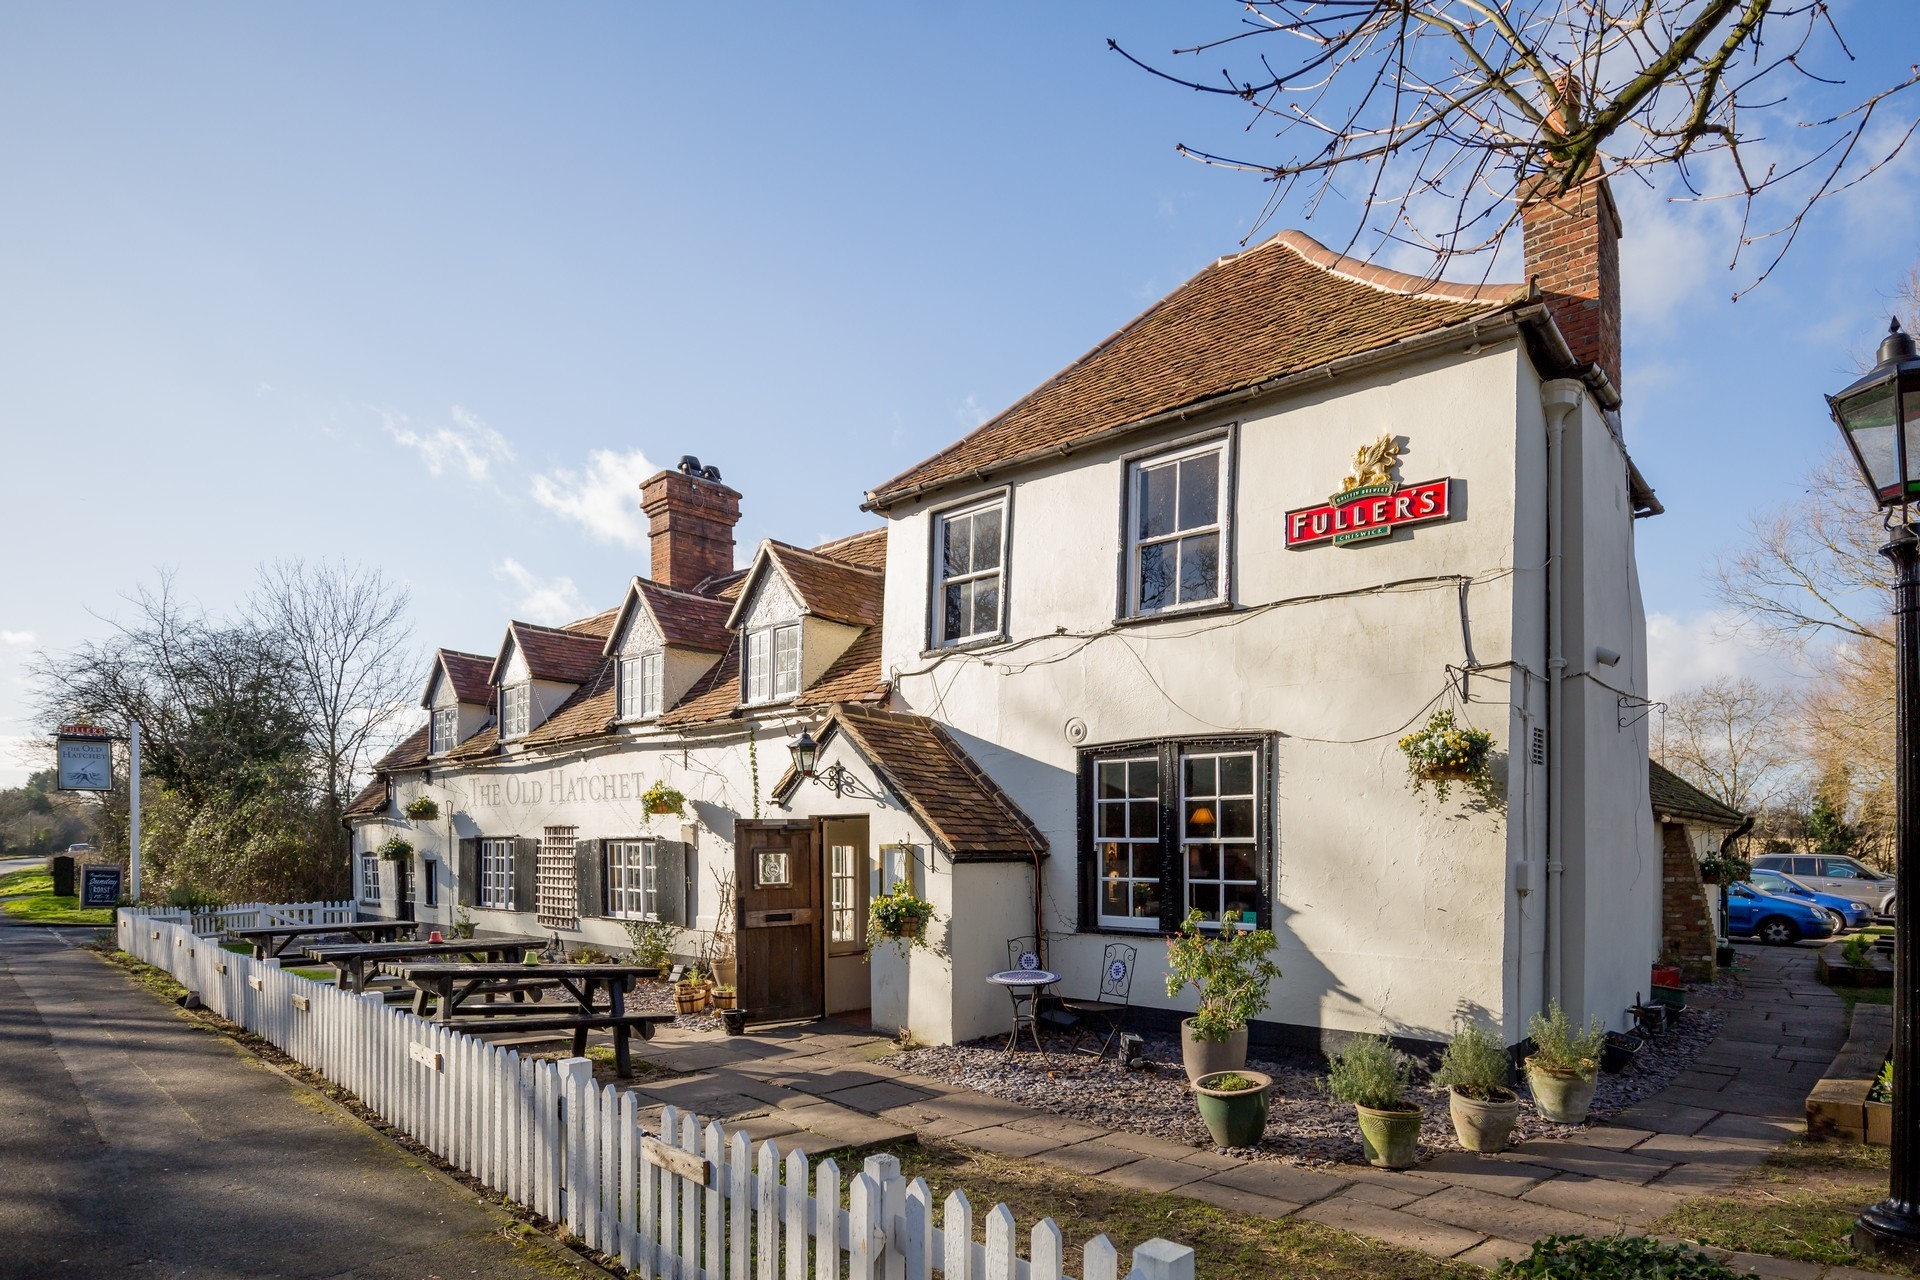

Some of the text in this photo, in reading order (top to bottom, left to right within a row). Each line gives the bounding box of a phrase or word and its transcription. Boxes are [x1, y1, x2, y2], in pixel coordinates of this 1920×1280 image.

[1361, 487, 1389, 495] BREWERY
[1293, 489, 1434, 538] FULLER'S
[1339, 528, 1383, 541] CHISWICK
[469, 777, 502, 807] THE
[89, 878, 118, 888] Sunday
